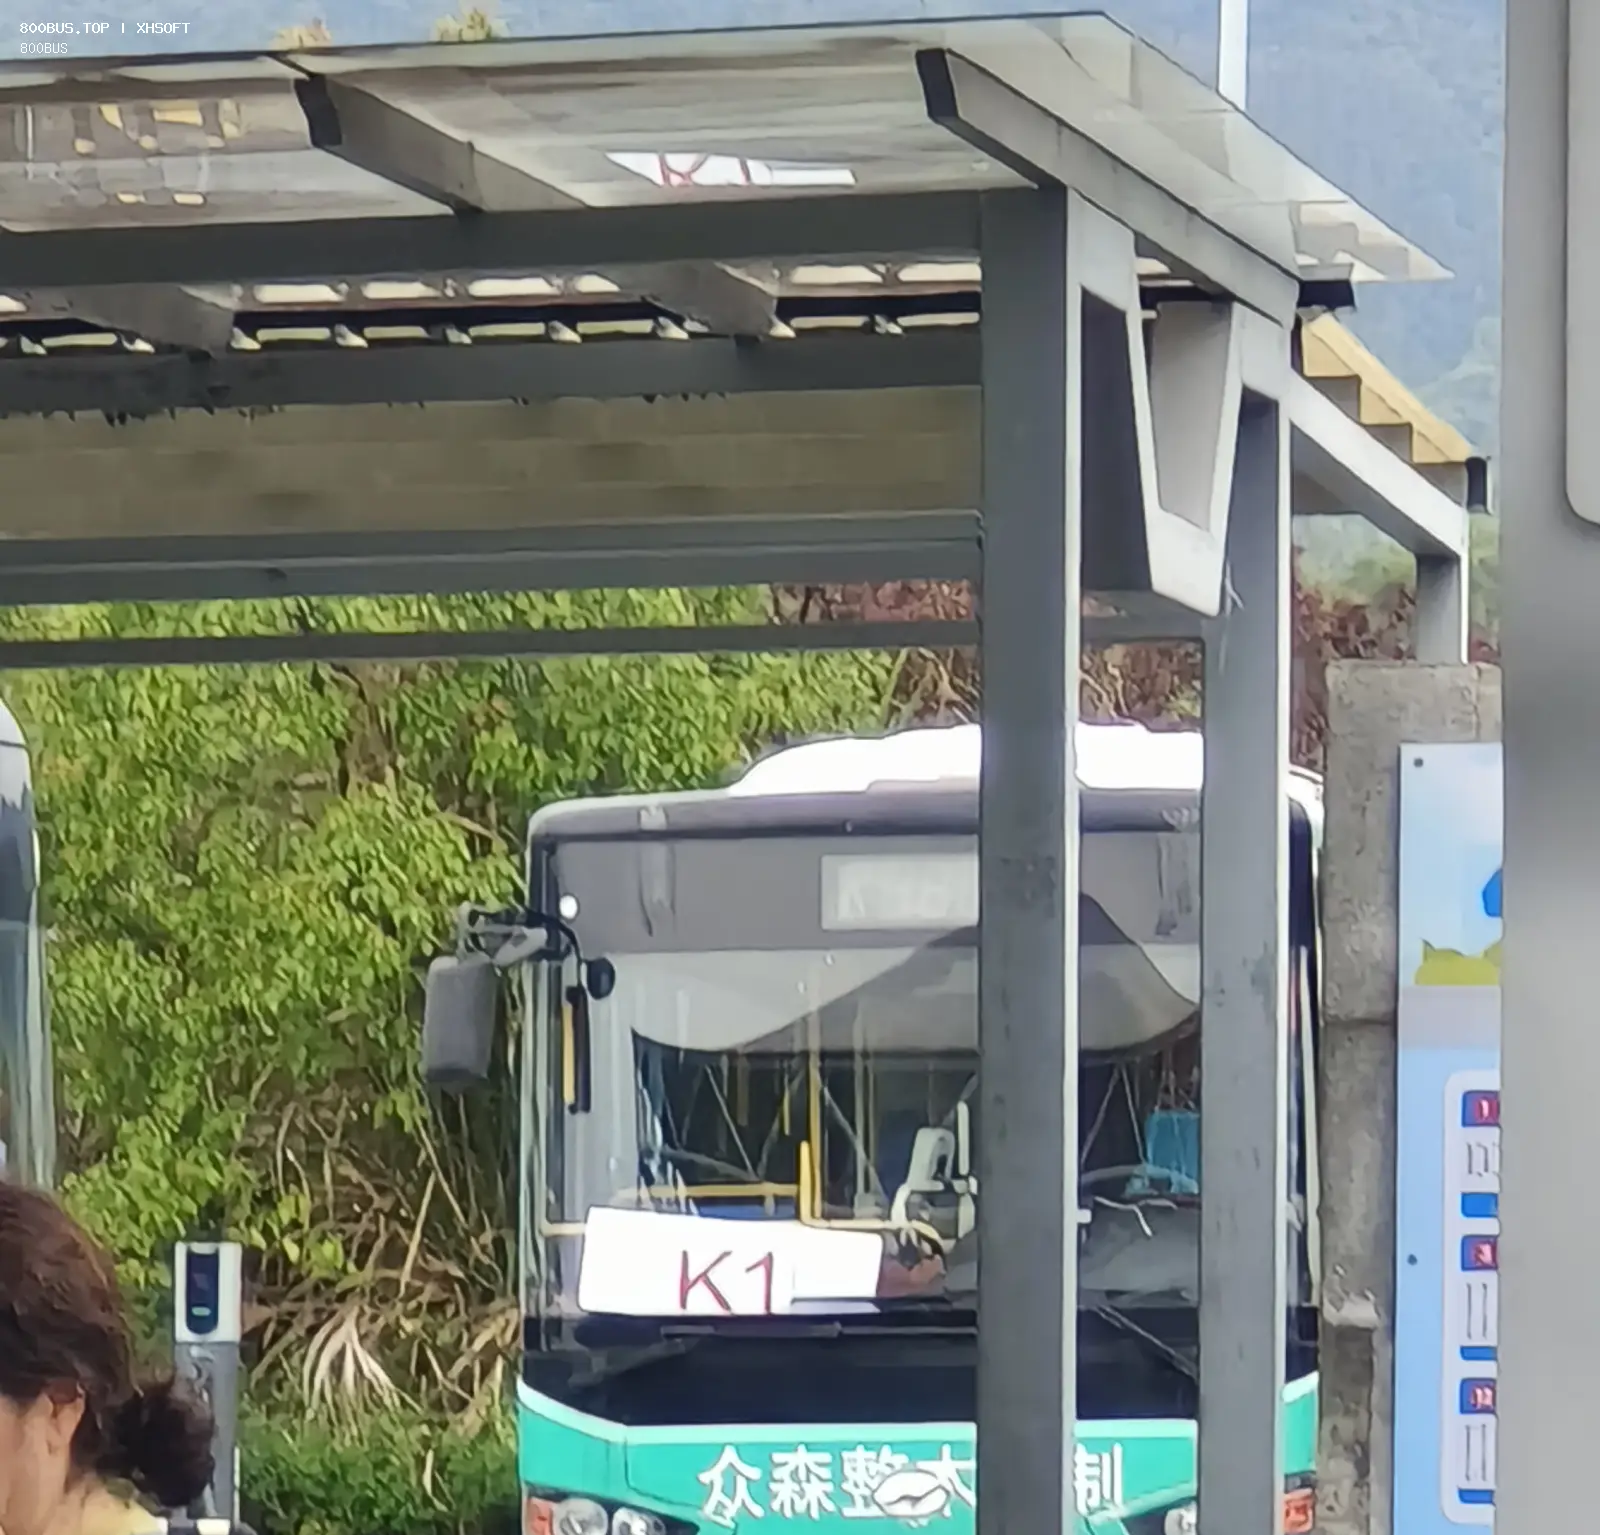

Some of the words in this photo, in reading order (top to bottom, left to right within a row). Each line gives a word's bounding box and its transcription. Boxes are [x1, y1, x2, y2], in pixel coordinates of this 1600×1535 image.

[679, 1249, 774, 1315] K1
[697, 1443, 1124, 1529] 众森整木制
